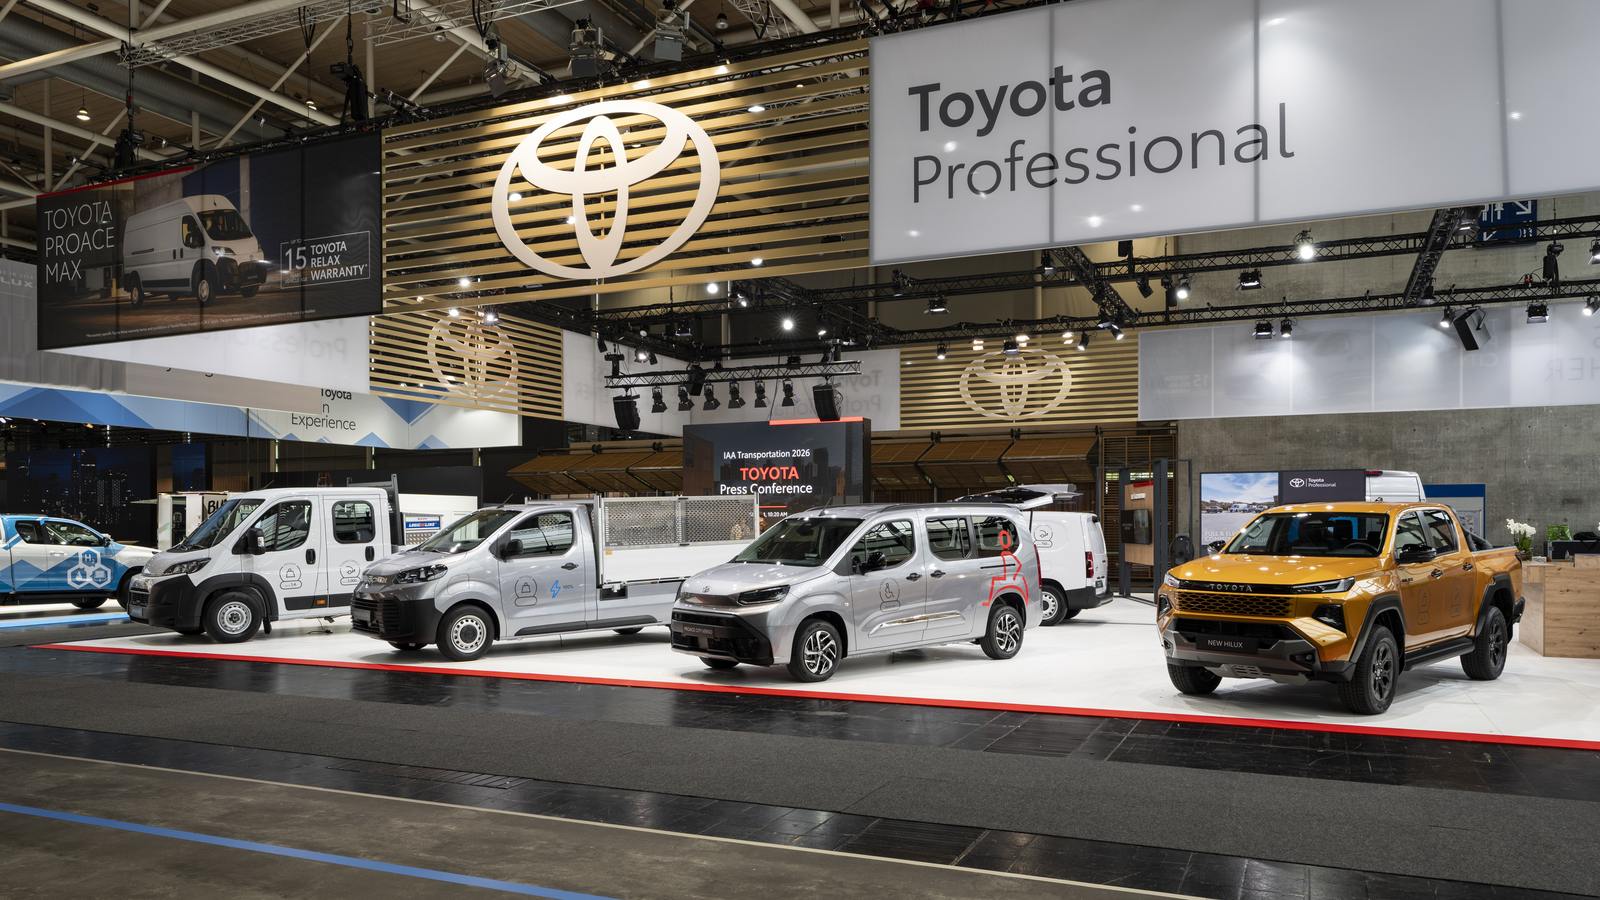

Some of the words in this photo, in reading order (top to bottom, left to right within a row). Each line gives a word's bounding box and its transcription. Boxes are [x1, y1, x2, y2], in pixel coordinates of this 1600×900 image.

[908, 65, 1111, 137] Toyota
[913, 102, 1295, 203] Professional
[44, 200, 113, 231] TOYOTA
[45, 226, 115, 258] PROACE
[310, 240, 347, 255] TOYOTA
[285, 246, 307, 271] 15
[310, 254, 341, 268] RELAX
[46, 258, 82, 284] MAX
[291, 413, 356, 430] Experience
[723, 451, 737, 460] IAA
[737, 449, 791, 460] Transportation
[791, 448, 811, 458] 2026
[739, 466, 800, 481] TOYOTA
[720, 483, 748, 495] Press
[750, 482, 813, 494] Conference
[1209, 583, 1253, 592] TOYOTA
[1207, 639, 1223, 647] NEW
[1223, 640, 1244, 648] HILUX
